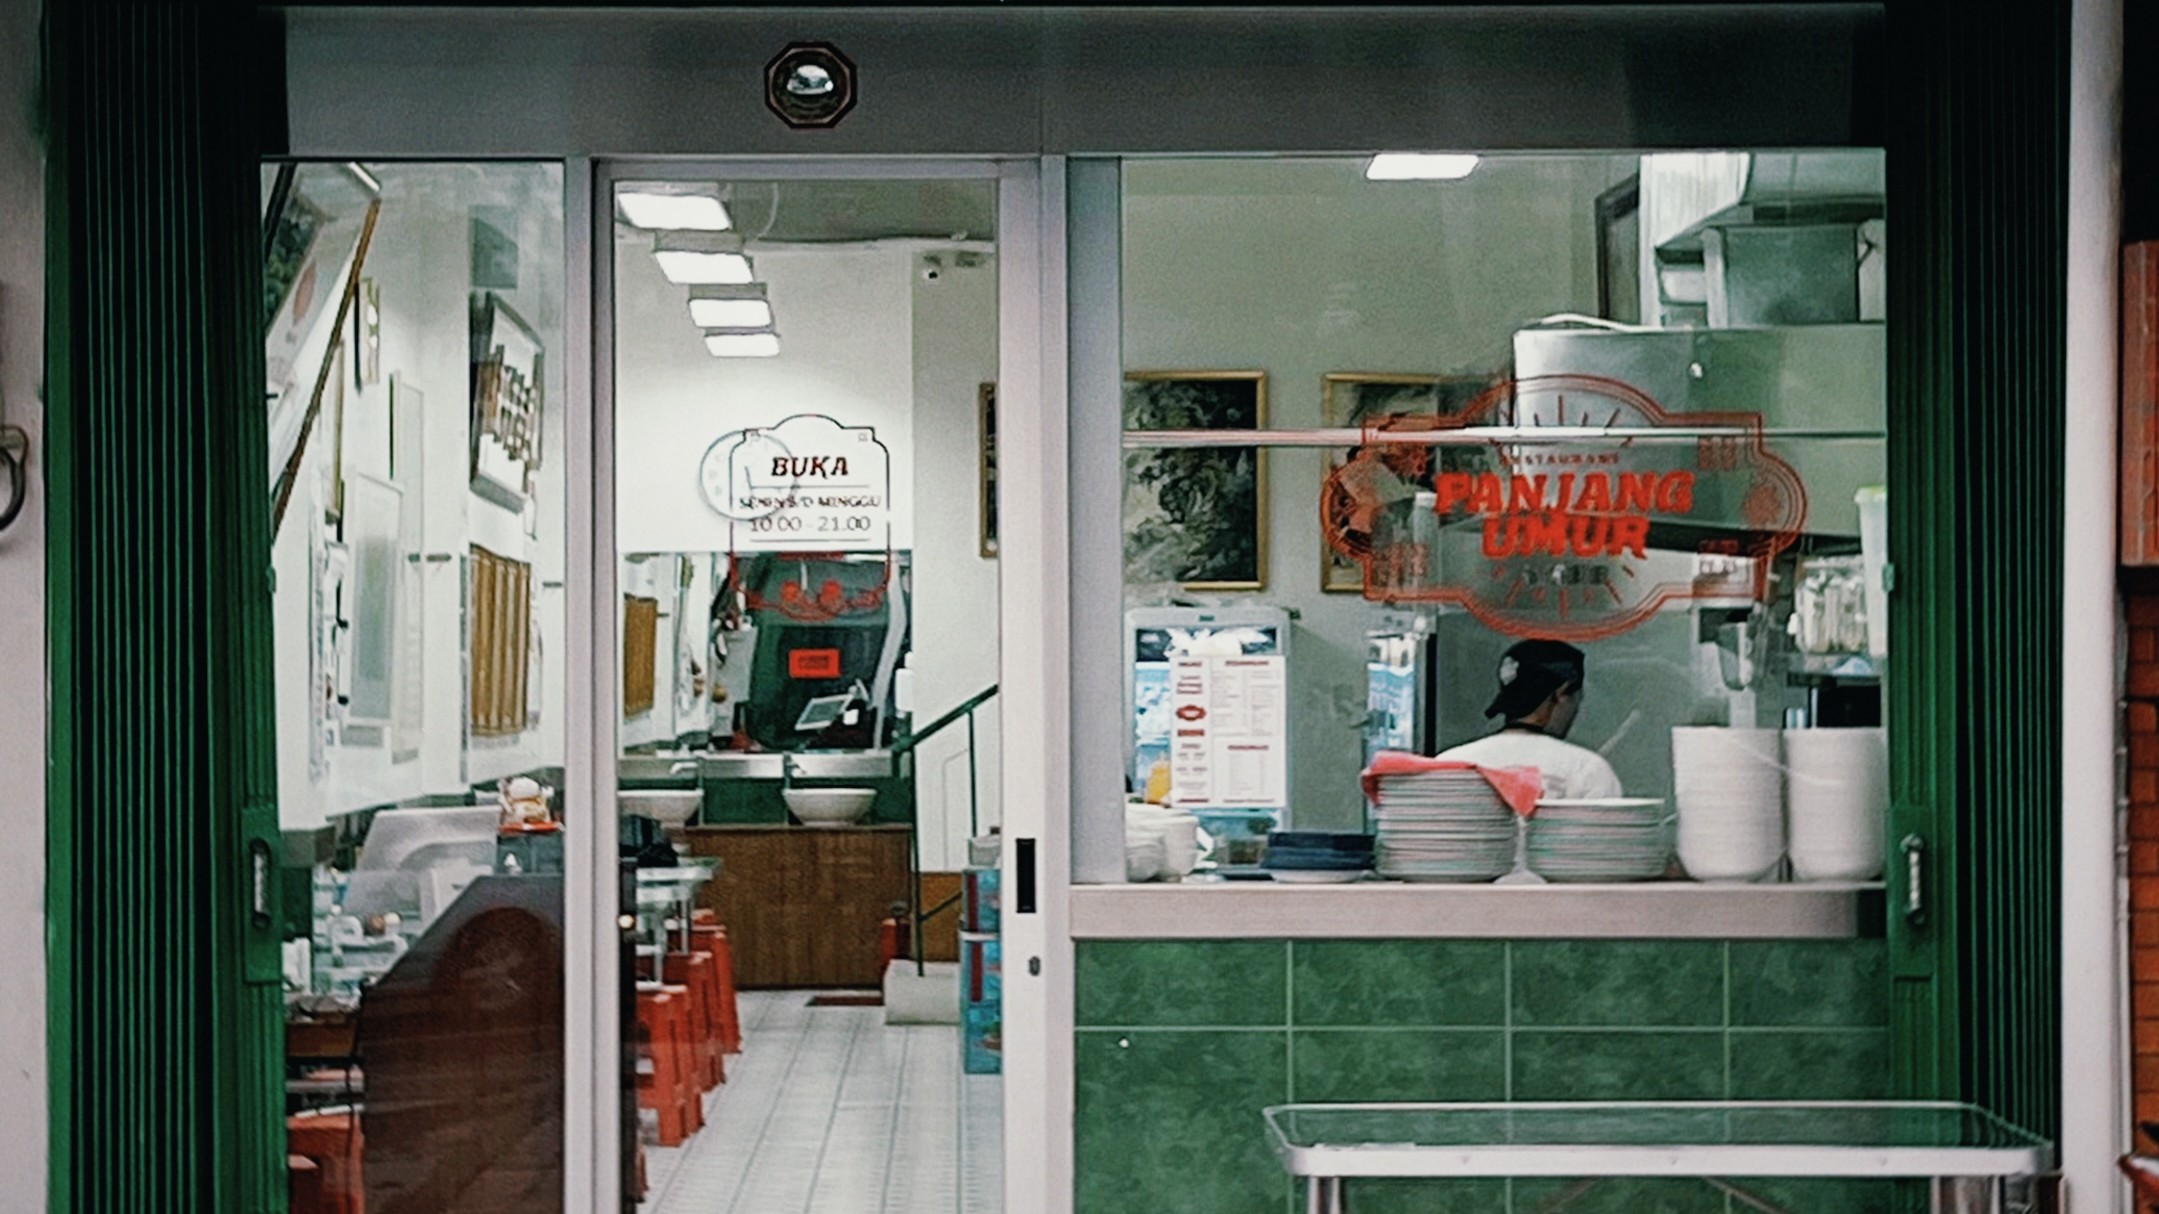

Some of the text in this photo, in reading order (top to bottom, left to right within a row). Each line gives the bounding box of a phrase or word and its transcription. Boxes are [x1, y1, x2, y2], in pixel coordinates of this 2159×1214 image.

[771, 456, 848, 479] BUKA
[818, 495, 881, 508] MINGGU
[1434, 470, 1696, 514] PANJANG
[818, 515, 871, 531] 21.00
[1482, 512, 1649, 560] UMUR
